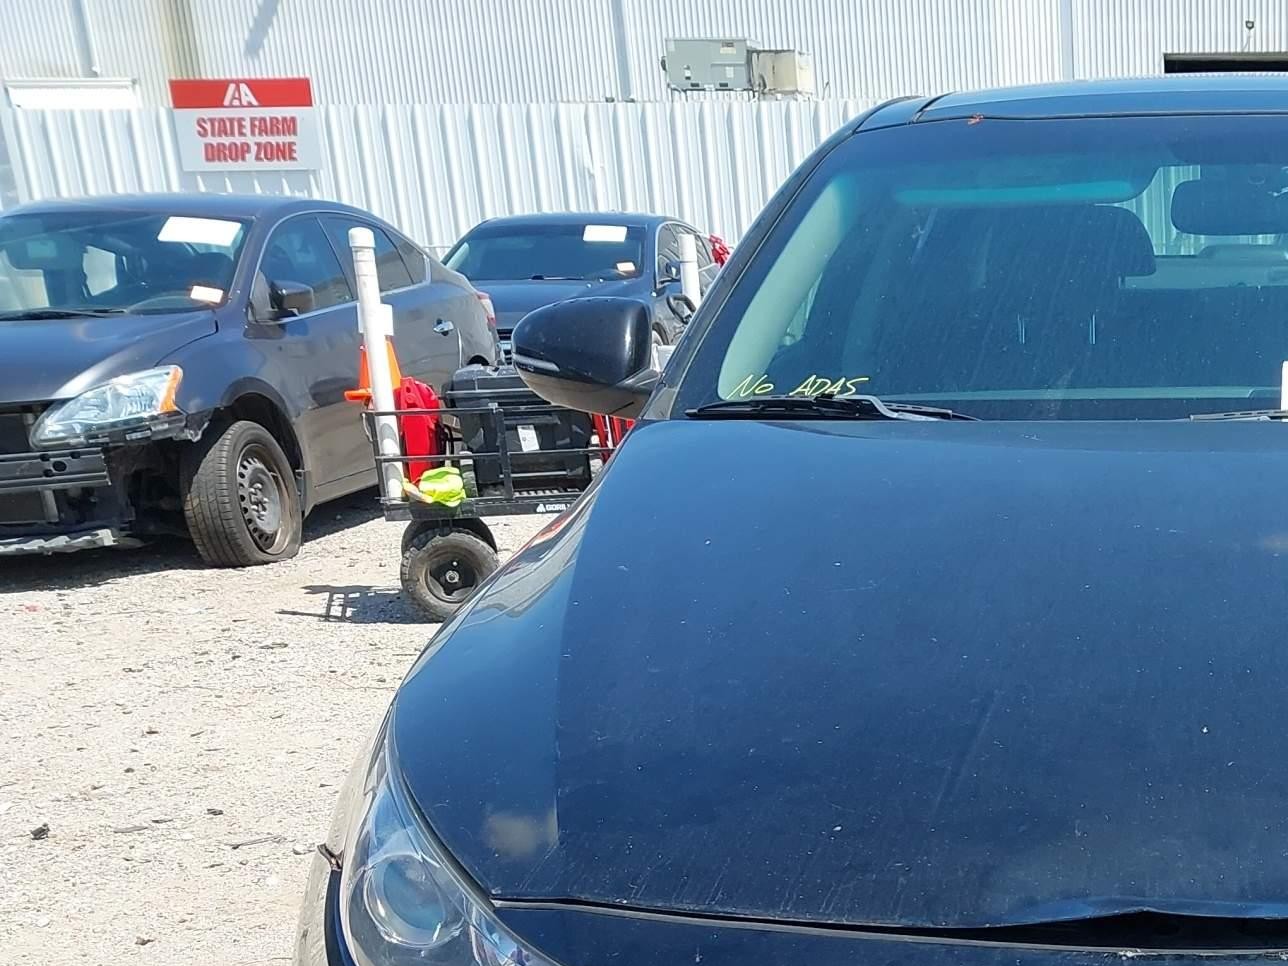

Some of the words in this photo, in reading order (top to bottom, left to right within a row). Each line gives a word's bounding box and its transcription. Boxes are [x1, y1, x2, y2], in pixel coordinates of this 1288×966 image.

[196, 117, 247, 137] STATE
[250, 116, 297, 136] FARM
[204, 142, 251, 162] DROP
[254, 141, 297, 162] ZONE
[726, 374, 774, 399] No
[788, 374, 869, 397] ADAS
